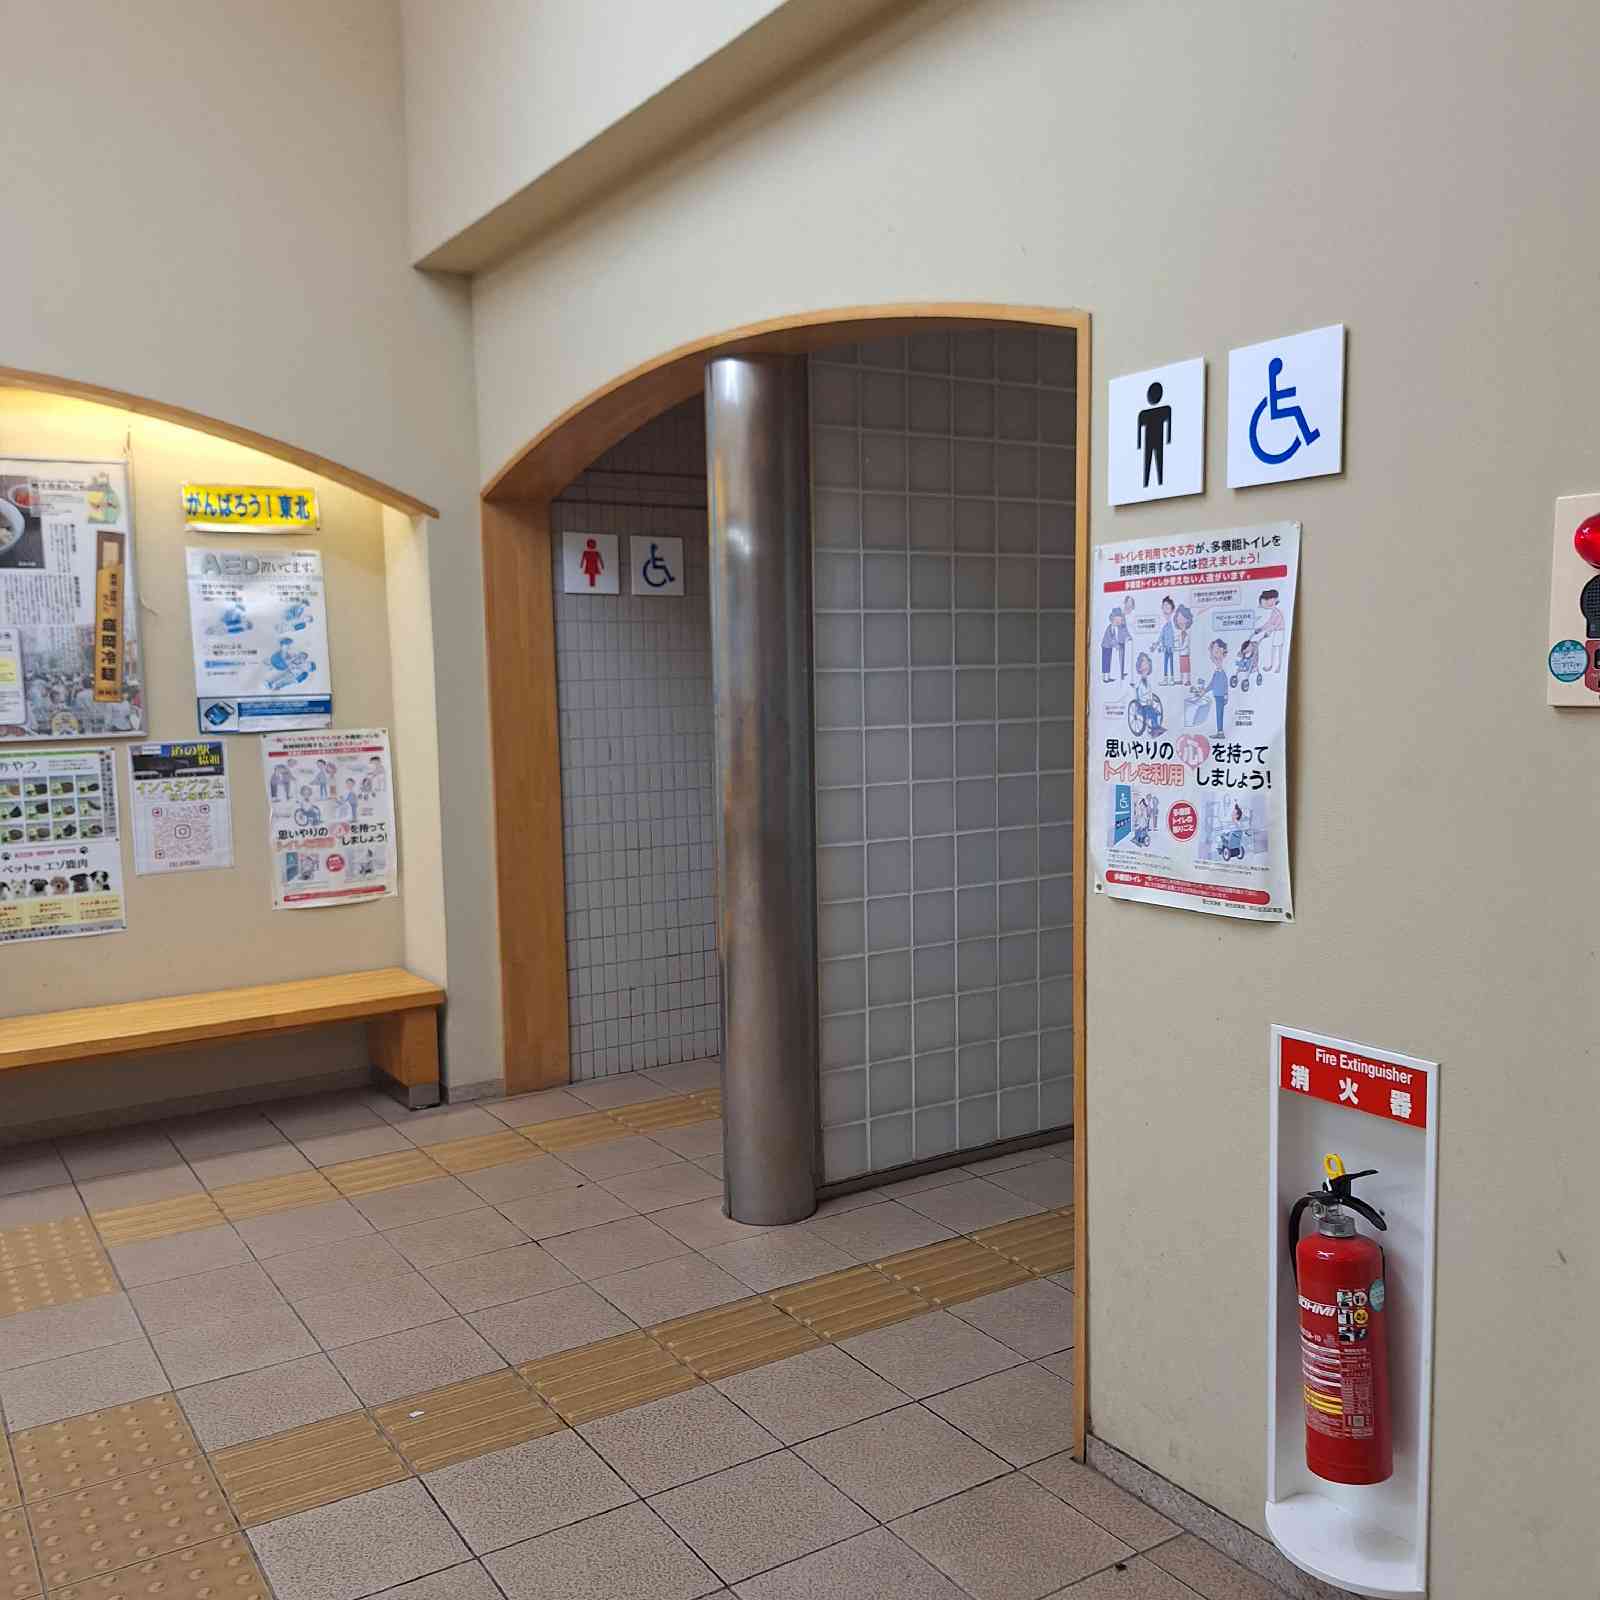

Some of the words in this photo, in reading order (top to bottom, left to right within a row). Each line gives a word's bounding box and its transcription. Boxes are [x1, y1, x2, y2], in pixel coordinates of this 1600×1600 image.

[187, 491, 310, 520] がんばろう！東北
[1105, 739, 1174, 760] 思いやりの
[1212, 742, 1269, 765] を持って
[1104, 760, 1185, 787] トイレを利用
[1315, 1048, 1337, 1066] Fire
[1339, 1054, 1413, 1085] Extinguisher
